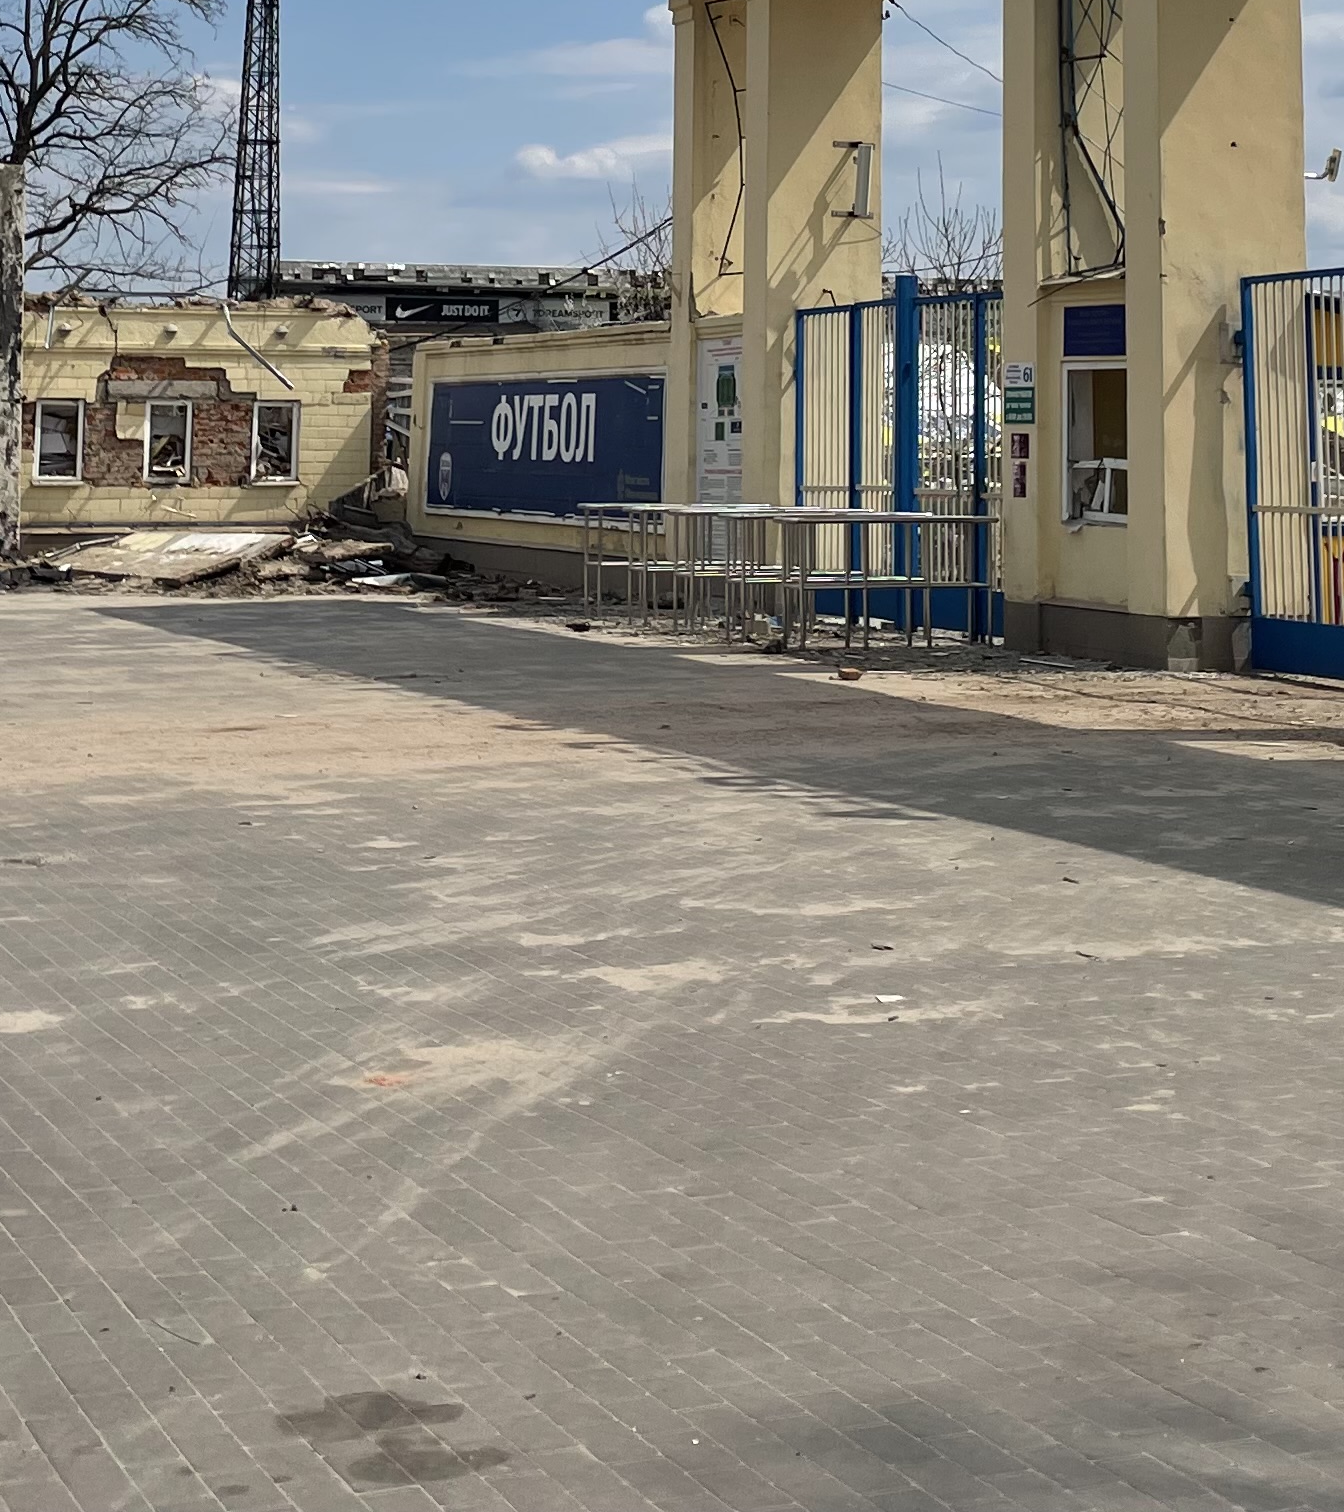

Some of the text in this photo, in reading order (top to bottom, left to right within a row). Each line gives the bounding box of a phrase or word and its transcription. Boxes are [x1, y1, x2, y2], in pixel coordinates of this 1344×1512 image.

[441, 304, 490, 316] JUST DO IT
[1023, 367, 1033, 383] 61
[491, 391, 597, 463] ФУТБОЛ
